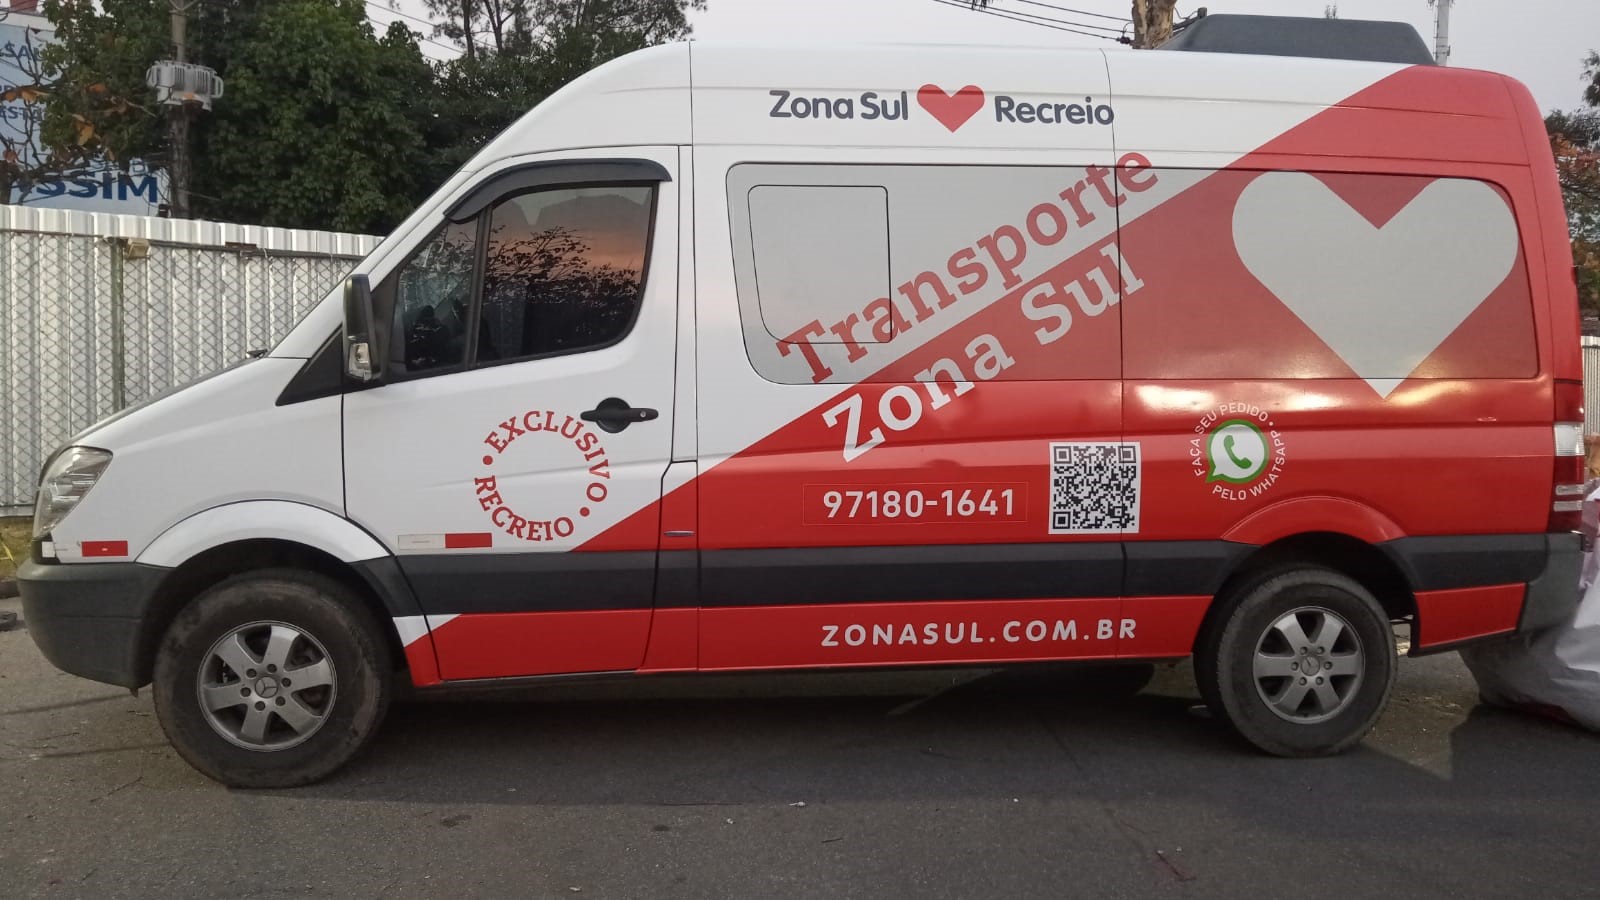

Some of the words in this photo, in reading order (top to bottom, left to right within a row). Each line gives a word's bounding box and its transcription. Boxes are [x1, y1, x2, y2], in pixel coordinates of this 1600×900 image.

[769, 89, 853, 119] Zona
[860, 91, 908, 121] Sul
[994, 95, 1114, 125] Recreio
[775, 152, 1159, 384] Transporte
[822, 332, 1016, 463] Zona
[1020, 241, 1144, 345] Sul
[1194, 410, 1217, 435] SEU
[1219, 402, 1268, 422] PEDIDO
[484, 410, 611, 502] EXCLUSIVO
[1190, 438, 1206, 477] FAÇA
[1212, 484, 1247, 501] PELO
[1249, 430, 1286, 497] WHATSAPP
[474, 475, 575, 542] RECREIO
[823, 488, 1014, 518] 97180-1641
[821, 618, 1137, 647] ZONASUL.COM.BR
